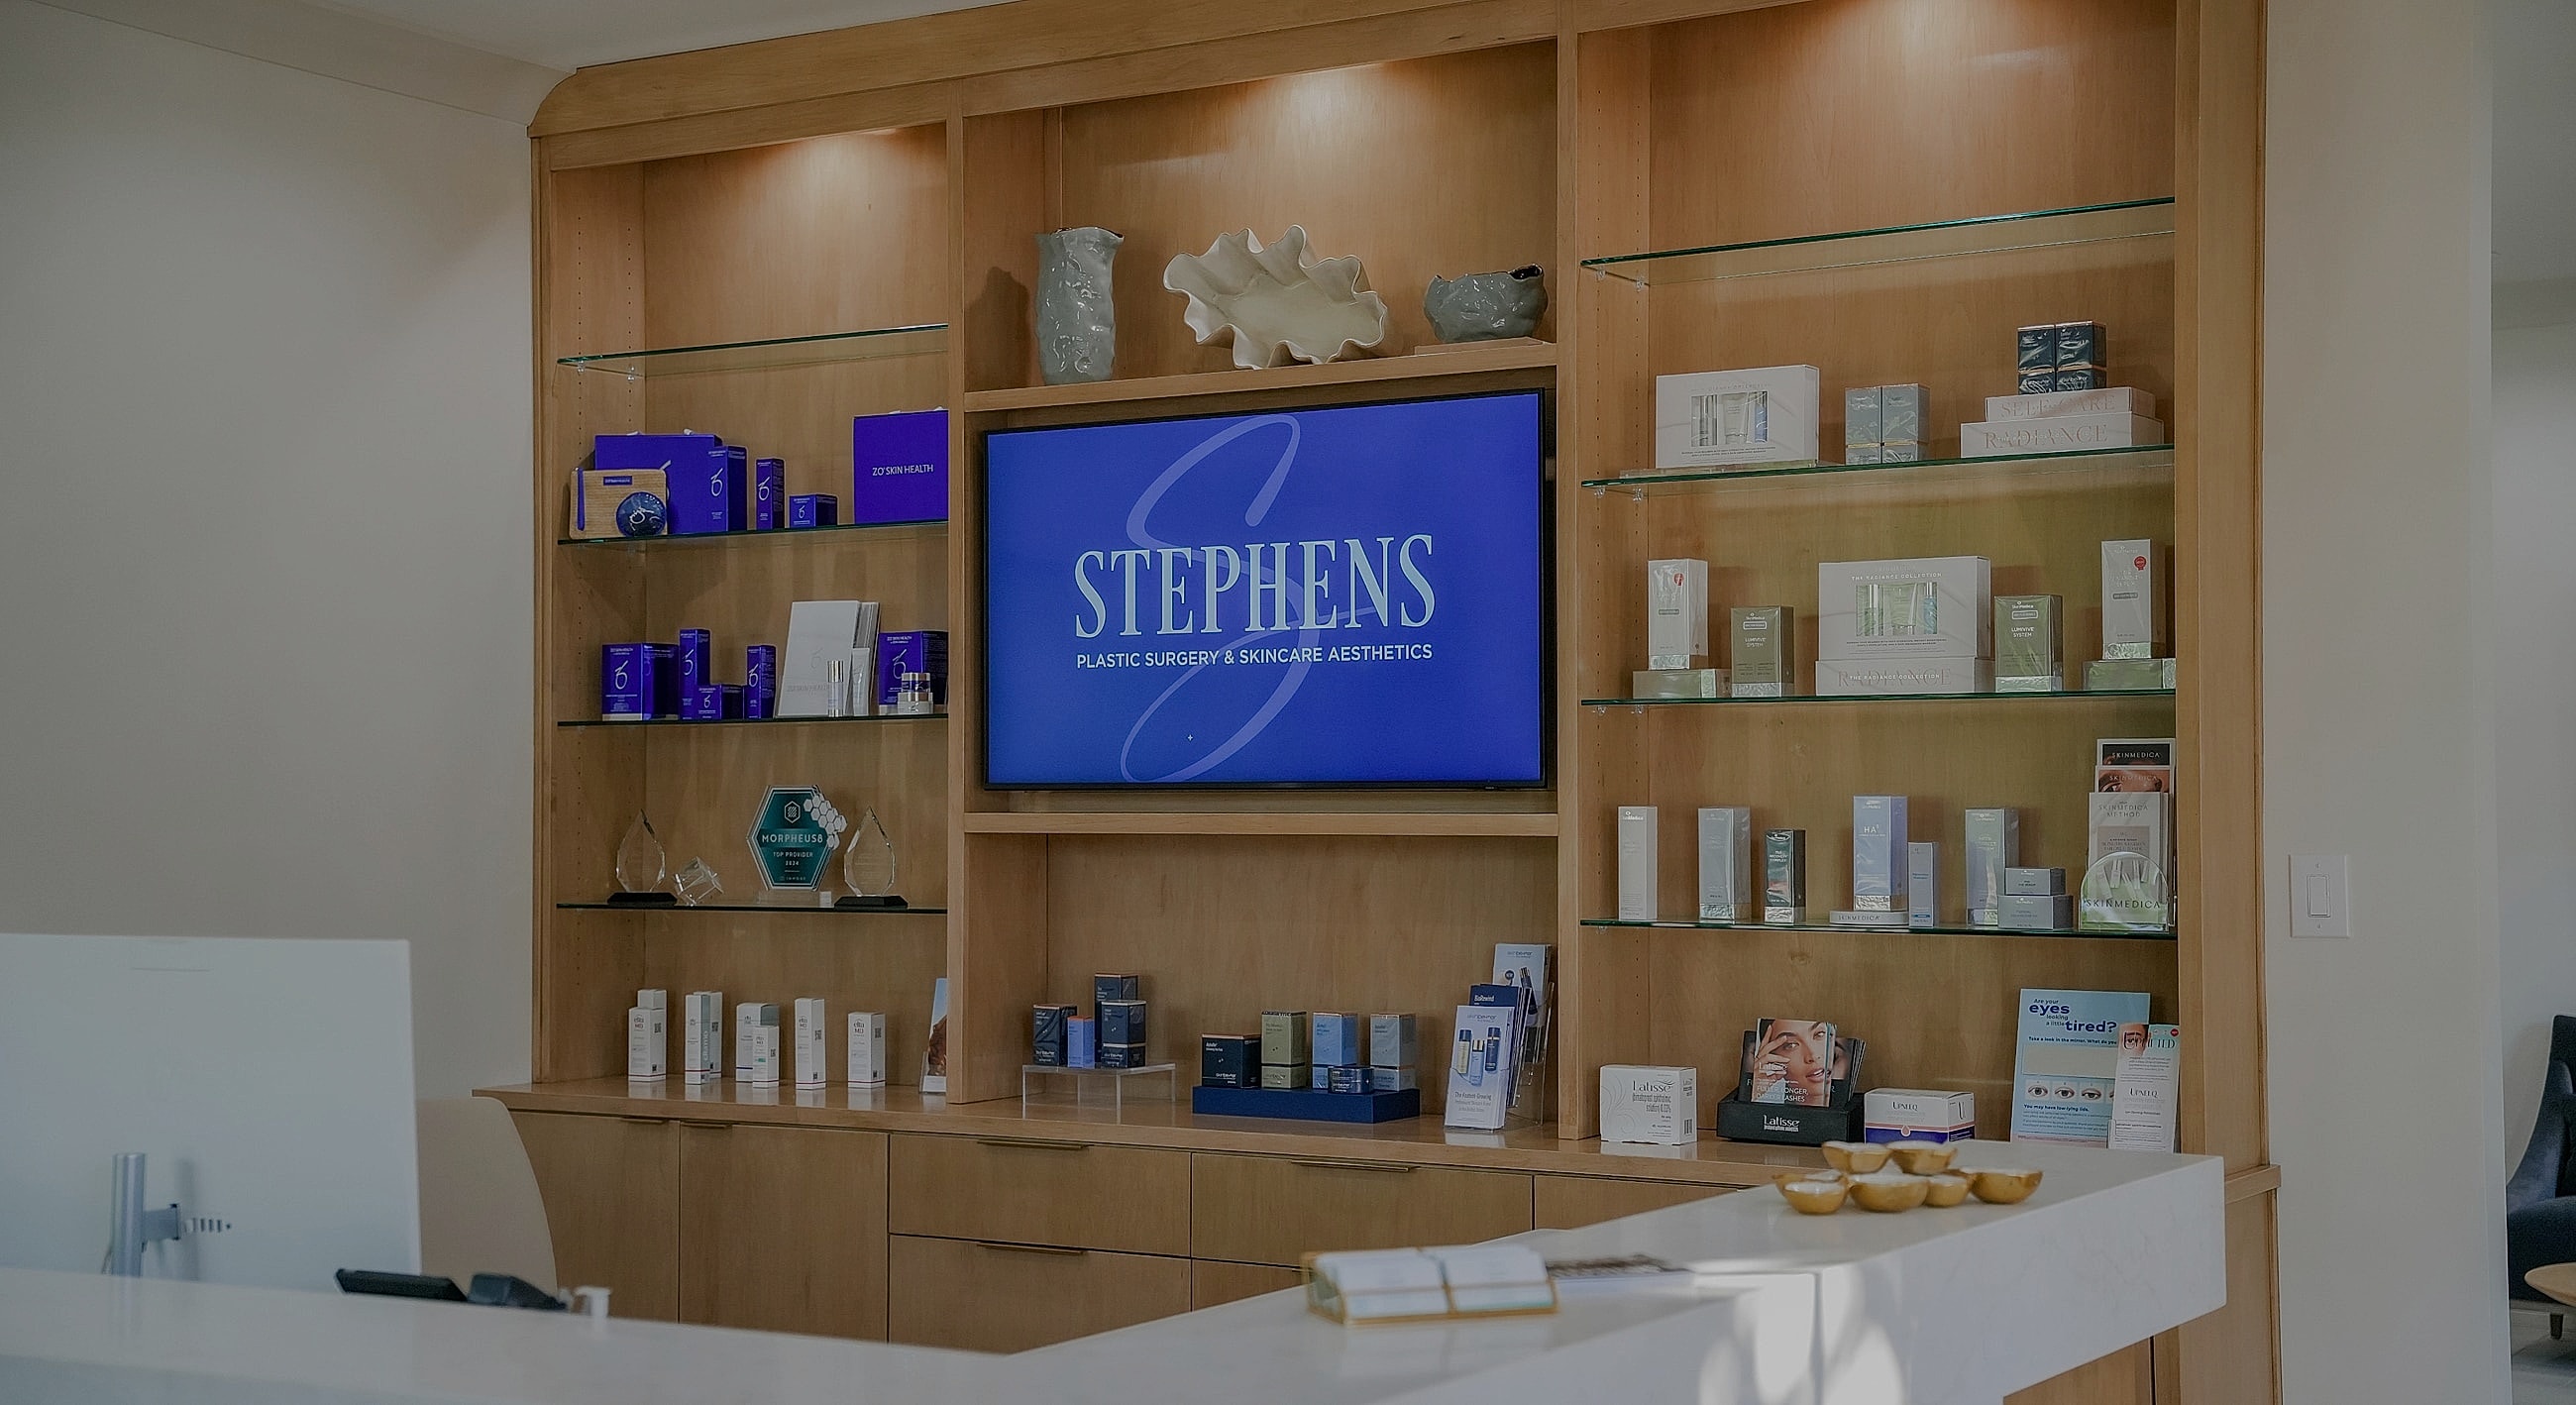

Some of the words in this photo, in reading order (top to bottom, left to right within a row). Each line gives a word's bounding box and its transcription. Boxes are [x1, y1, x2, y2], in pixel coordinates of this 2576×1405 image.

[886, 466, 903, 476] SKIN
[904, 464, 934, 475] HEALTH
[1074, 533, 1437, 639] STEPHENS
[1076, 651, 1140, 670] PLASTIC
[1144, 649, 1222, 667] SURGERY
[1224, 649, 1235, 664] &
[1238, 645, 1324, 664] SKINCARE
[1328, 643, 1433, 662] AESTHETICS
[761, 833, 823, 843] MORPHEUS8
[2086, 899, 2160, 909] SKINMEDICA
[2029, 1004, 2070, 1016] eyes
[2065, 1020, 2117, 1032] tired?
[1633, 1080, 1672, 1092] Latisse
[1764, 1115, 1800, 1128] Latisse
